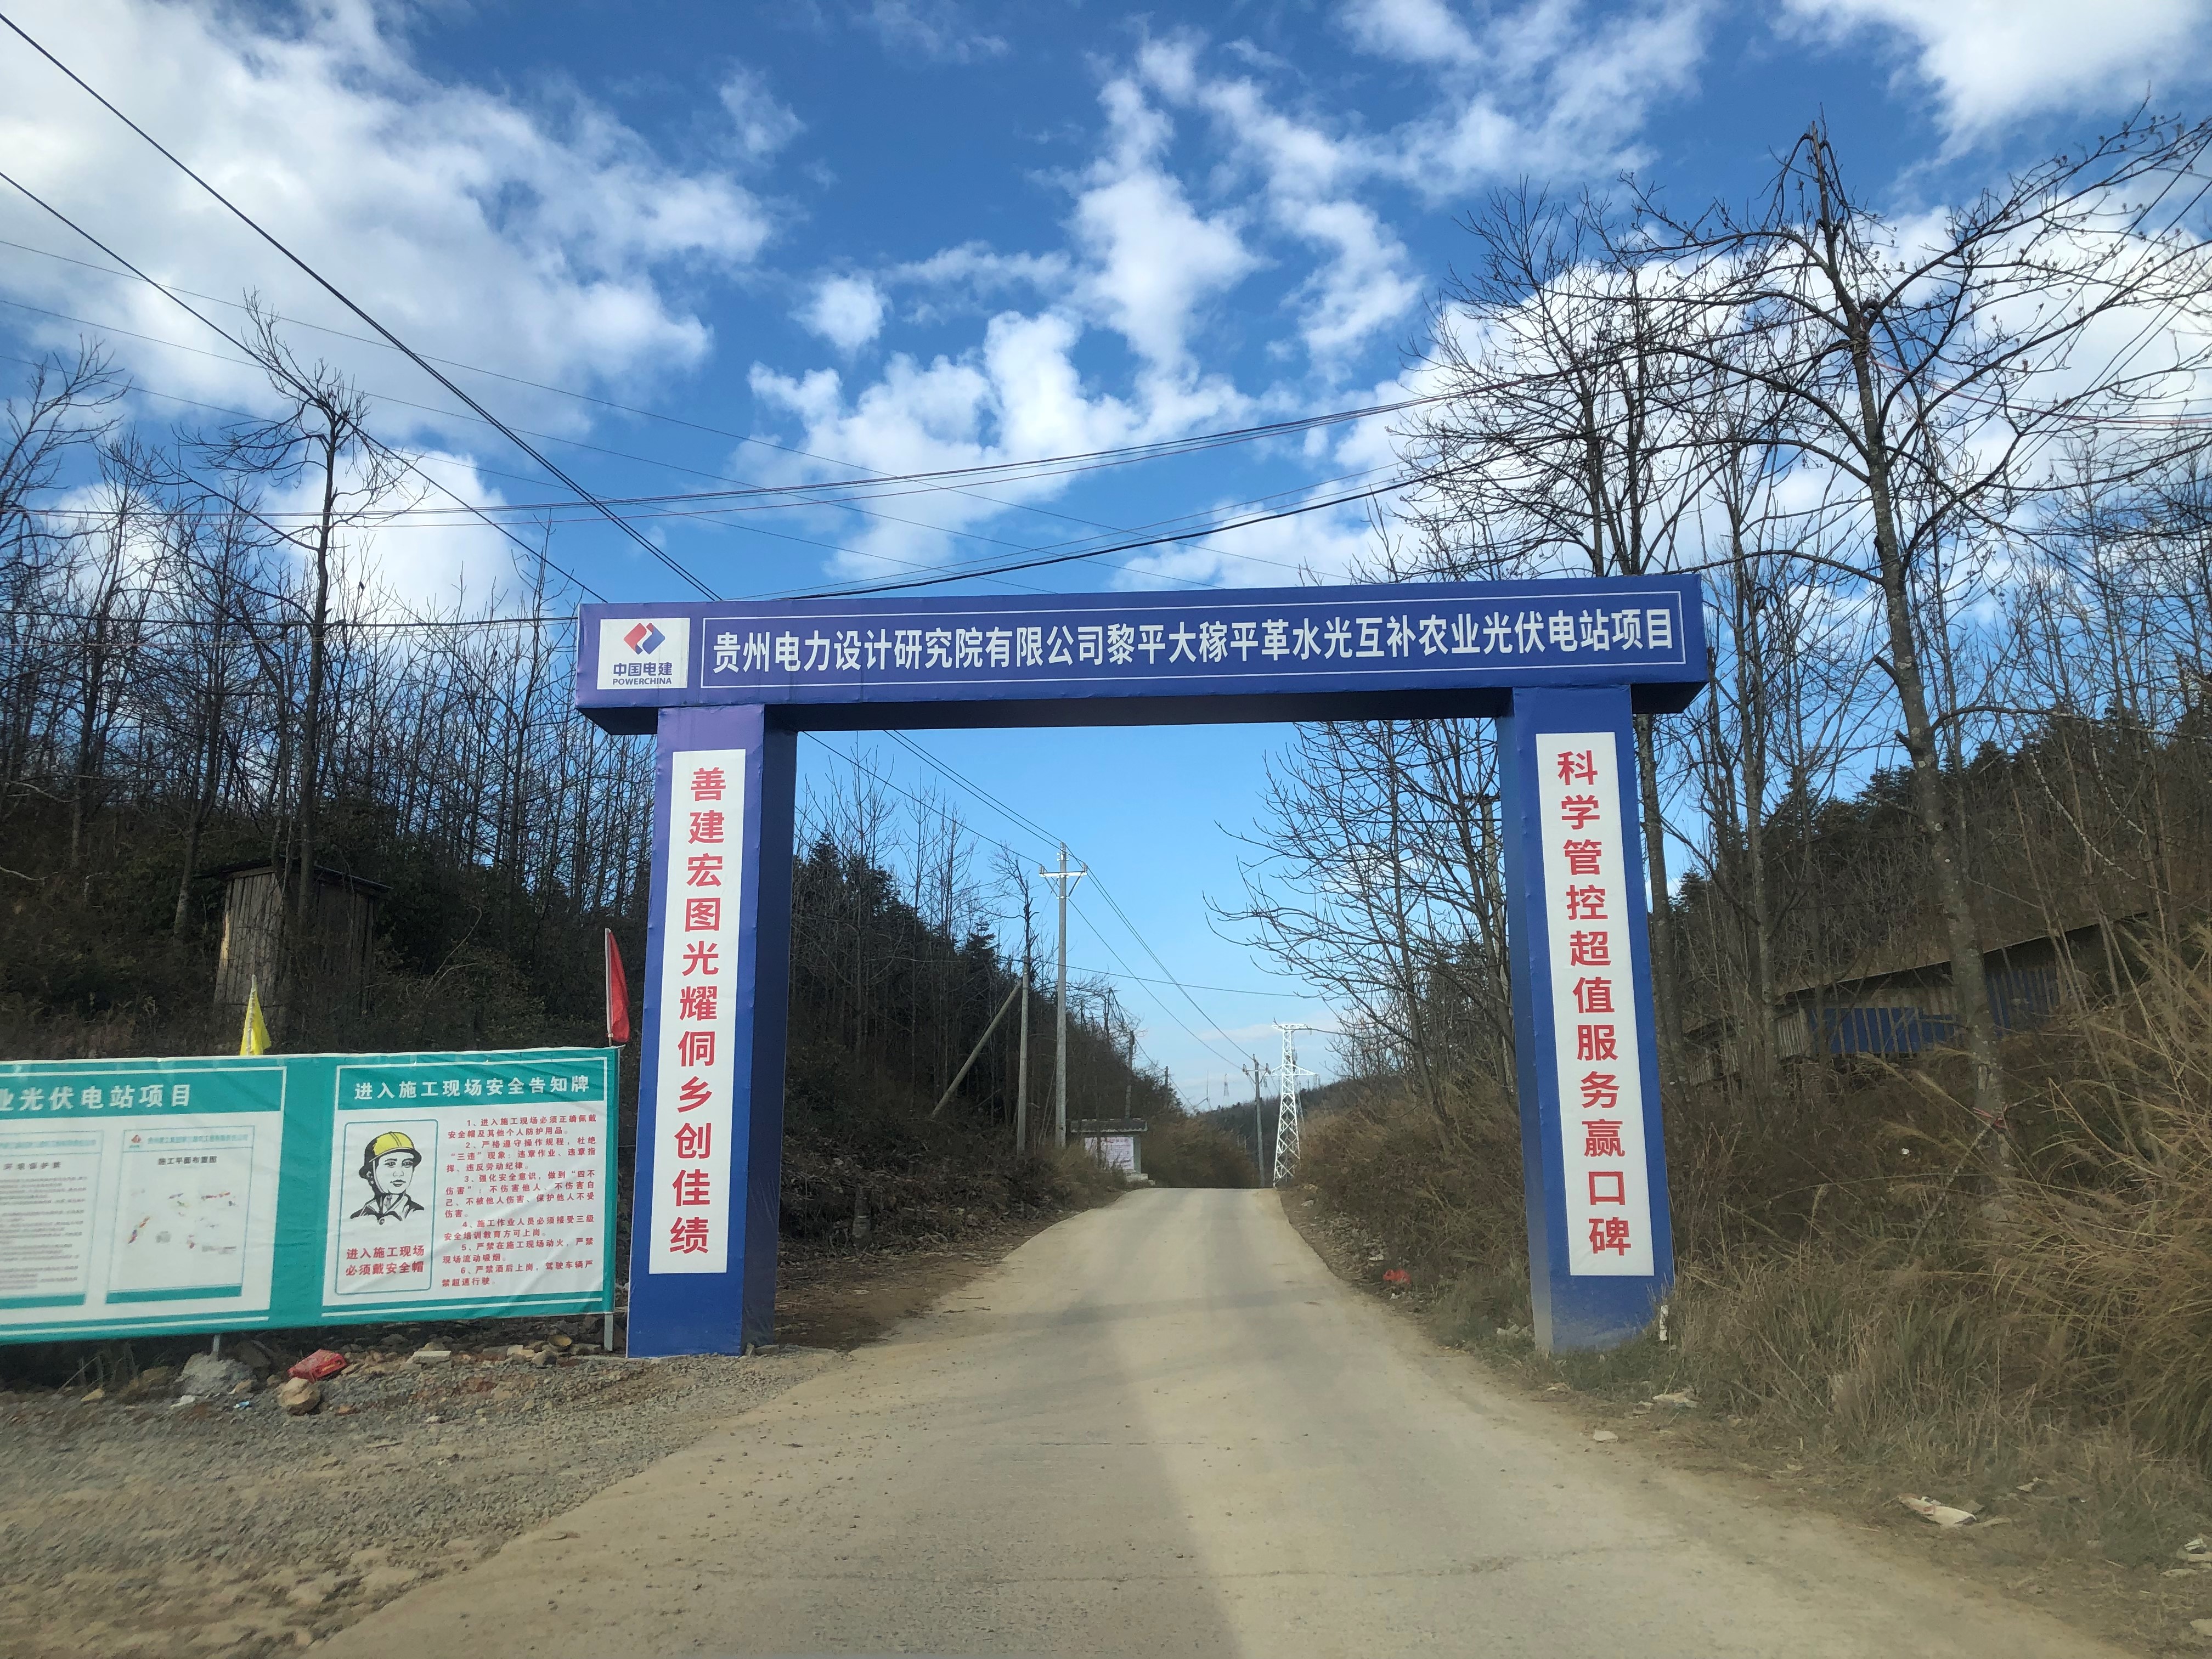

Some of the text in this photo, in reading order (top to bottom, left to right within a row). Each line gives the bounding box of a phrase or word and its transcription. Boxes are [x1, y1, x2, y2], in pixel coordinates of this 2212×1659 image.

[713, 608, 1673, 673] 贵州电力设计研究院有限公司黎平大稼平革水光互补农业光伏电站项目
[613, 662, 673, 676] 中国电建
[1557, 751, 1632, 1256] 科学管控超值服务赢口碑
[669, 766, 726, 1255] 善建宏图光耀侗乡创佳绩
[354, 1075, 589, 1101] 进入施工现场安全告知牌
[467, 1114, 596, 1126] 1、进入施工现场必须正确佩戴
[448, 1126, 568, 1139] 安全帽及其他个人防护用品。
[465, 1136, 596, 1149] 2、严格遵守操作规程，杜绝
[446, 1162, 529, 1173] 挥、违反劳动纪律。
[445, 1192, 594, 1207] 己、不被他人伤害、保护他人不受
[444, 1209, 468, 1218] 伤害。
[462, 1215, 594, 1228] 4、施工作业人员必须接受三级
[444, 1228, 546, 1241] 安全培训教育方可上岗。
[346, 1245, 425, 1260] 进入施工现场
[443, 1253, 506, 1264] 现场流动吸烟。
[346, 1261, 424, 1276] 必须戴安全帽
[442, 1277, 495, 1288] 禁超速行驶。
